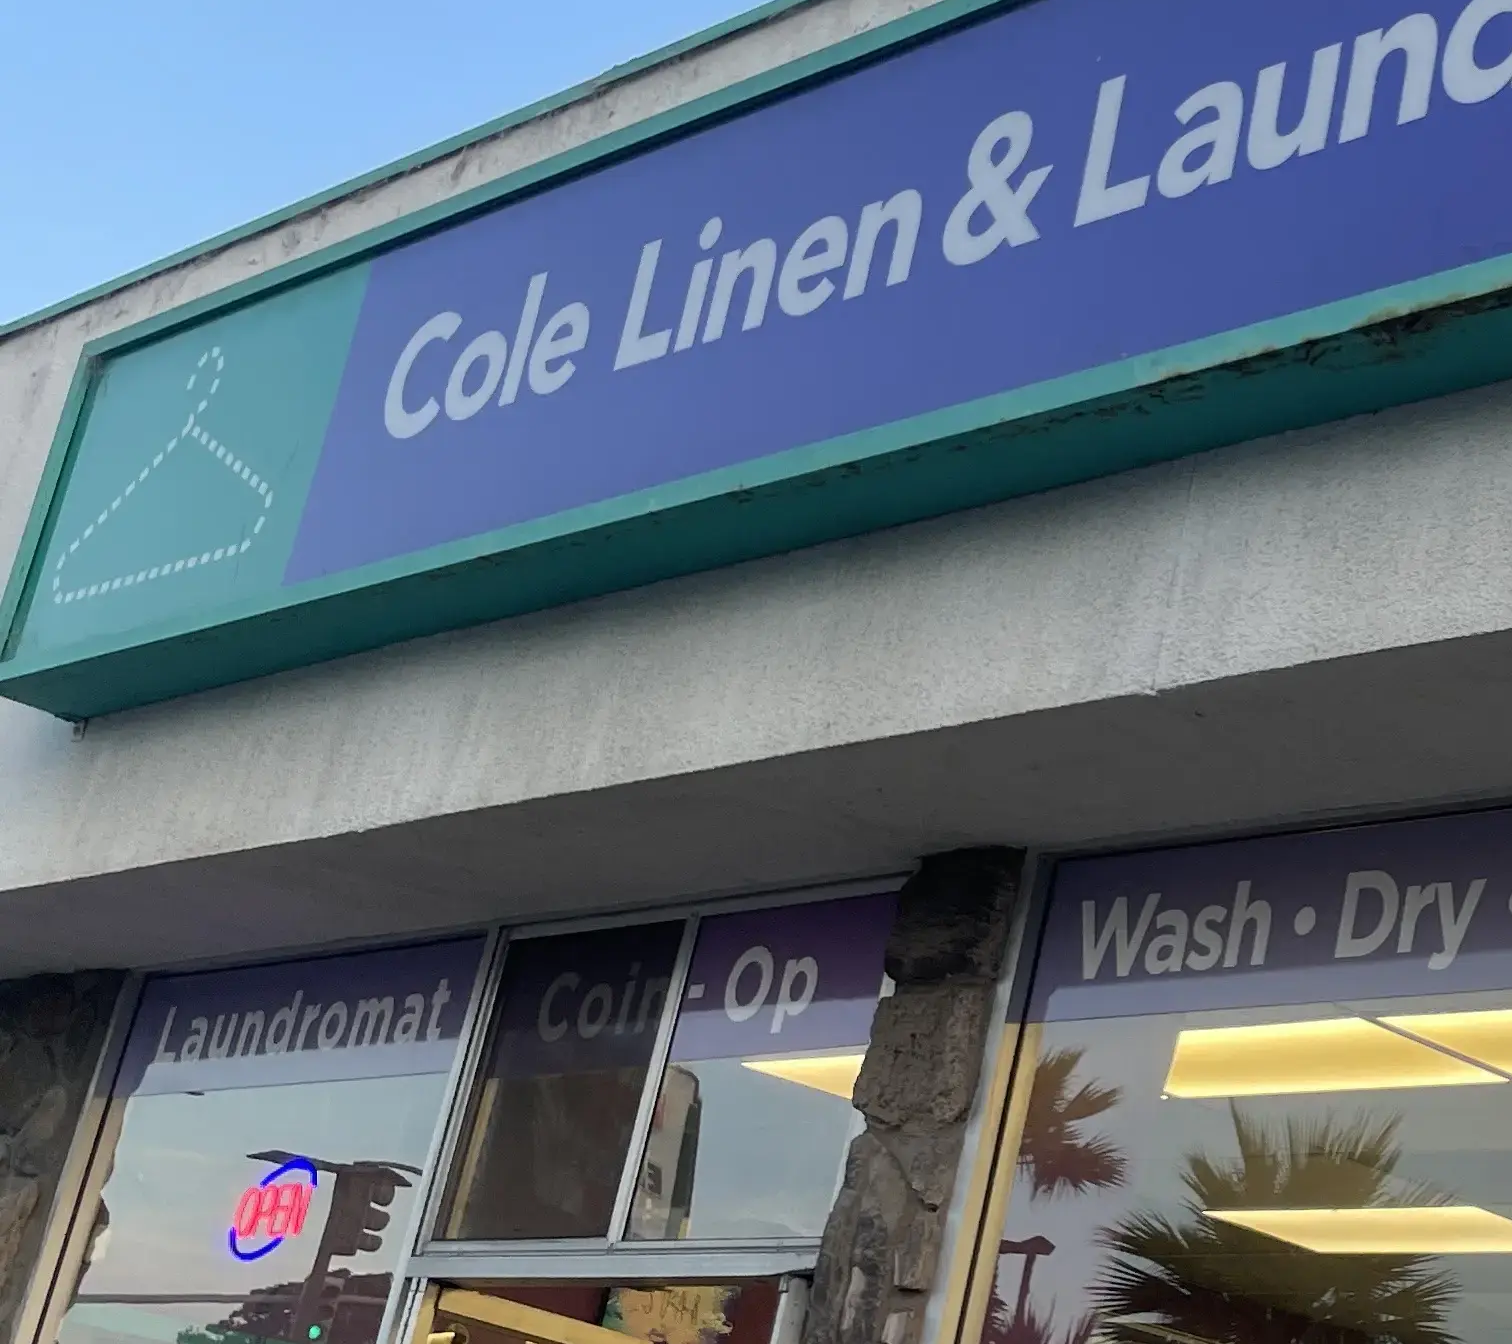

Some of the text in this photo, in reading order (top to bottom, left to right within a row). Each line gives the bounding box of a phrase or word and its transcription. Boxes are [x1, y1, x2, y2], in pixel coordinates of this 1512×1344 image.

[381, 267, 591, 441] Cole
[613, 188, 923, 375] Linen
[941, 109, 1054, 268] &
[1081, 880, 1272, 980] Wash
[1334, 870, 1488, 970] Dry
[153, 977, 452, 1065] Laundromat
[233, 1182, 313, 1240] OPEN
